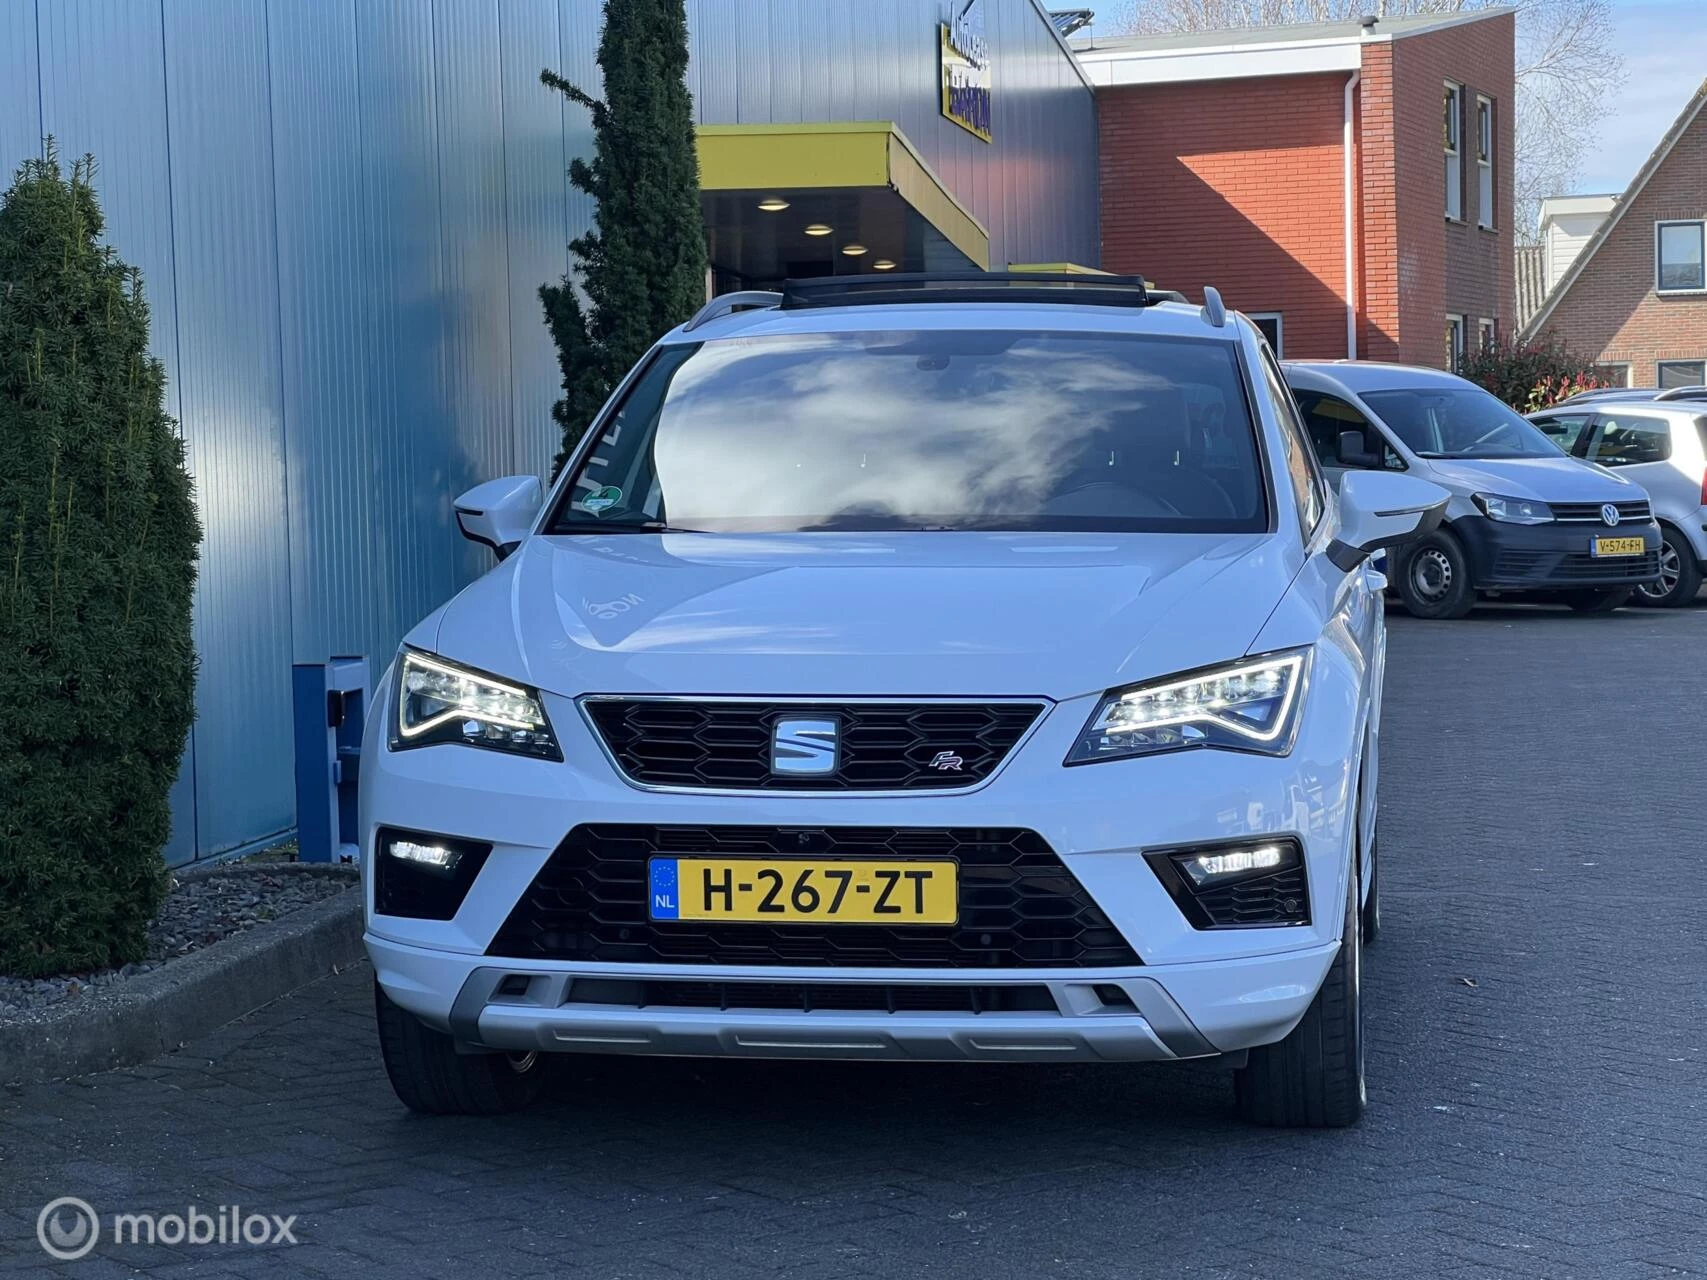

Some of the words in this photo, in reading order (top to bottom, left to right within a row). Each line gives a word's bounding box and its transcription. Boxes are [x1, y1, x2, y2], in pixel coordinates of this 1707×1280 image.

[1600, 539, 1641, 552] V-574-FH
[928, 750, 963, 771] FR
[655, 894, 675, 909] NL
[703, 867, 933, 915] H-267-ZT
